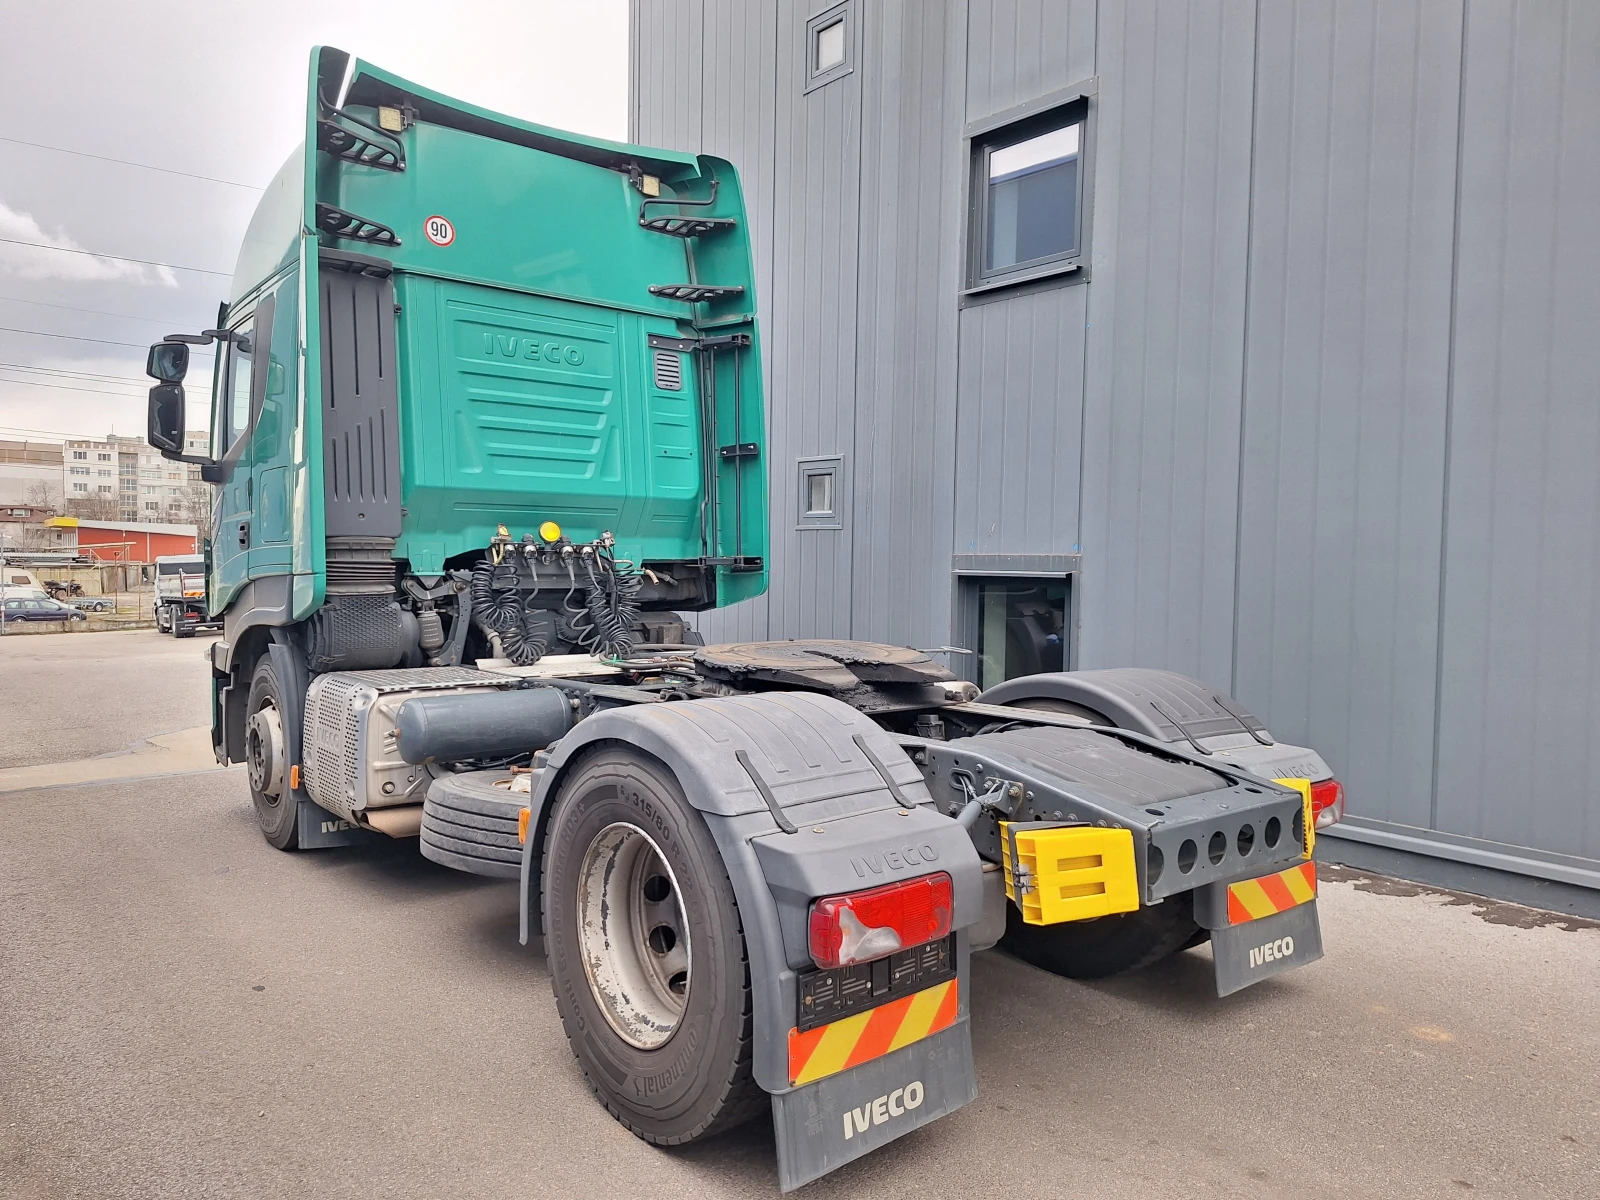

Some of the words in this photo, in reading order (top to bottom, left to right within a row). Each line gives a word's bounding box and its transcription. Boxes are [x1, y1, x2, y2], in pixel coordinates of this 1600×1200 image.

[430, 222, 446, 239] 90
[483, 332, 584, 366] IVECO
[316, 726, 340, 752] IVECO
[1272, 763, 1320, 779] IVECO
[632, 791, 671, 842] 315/80
[670, 840, 681, 860] R
[849, 841, 940, 878] IVECO
[1249, 935, 1295, 969] IVECO
[842, 1080, 925, 1141] IVECO
